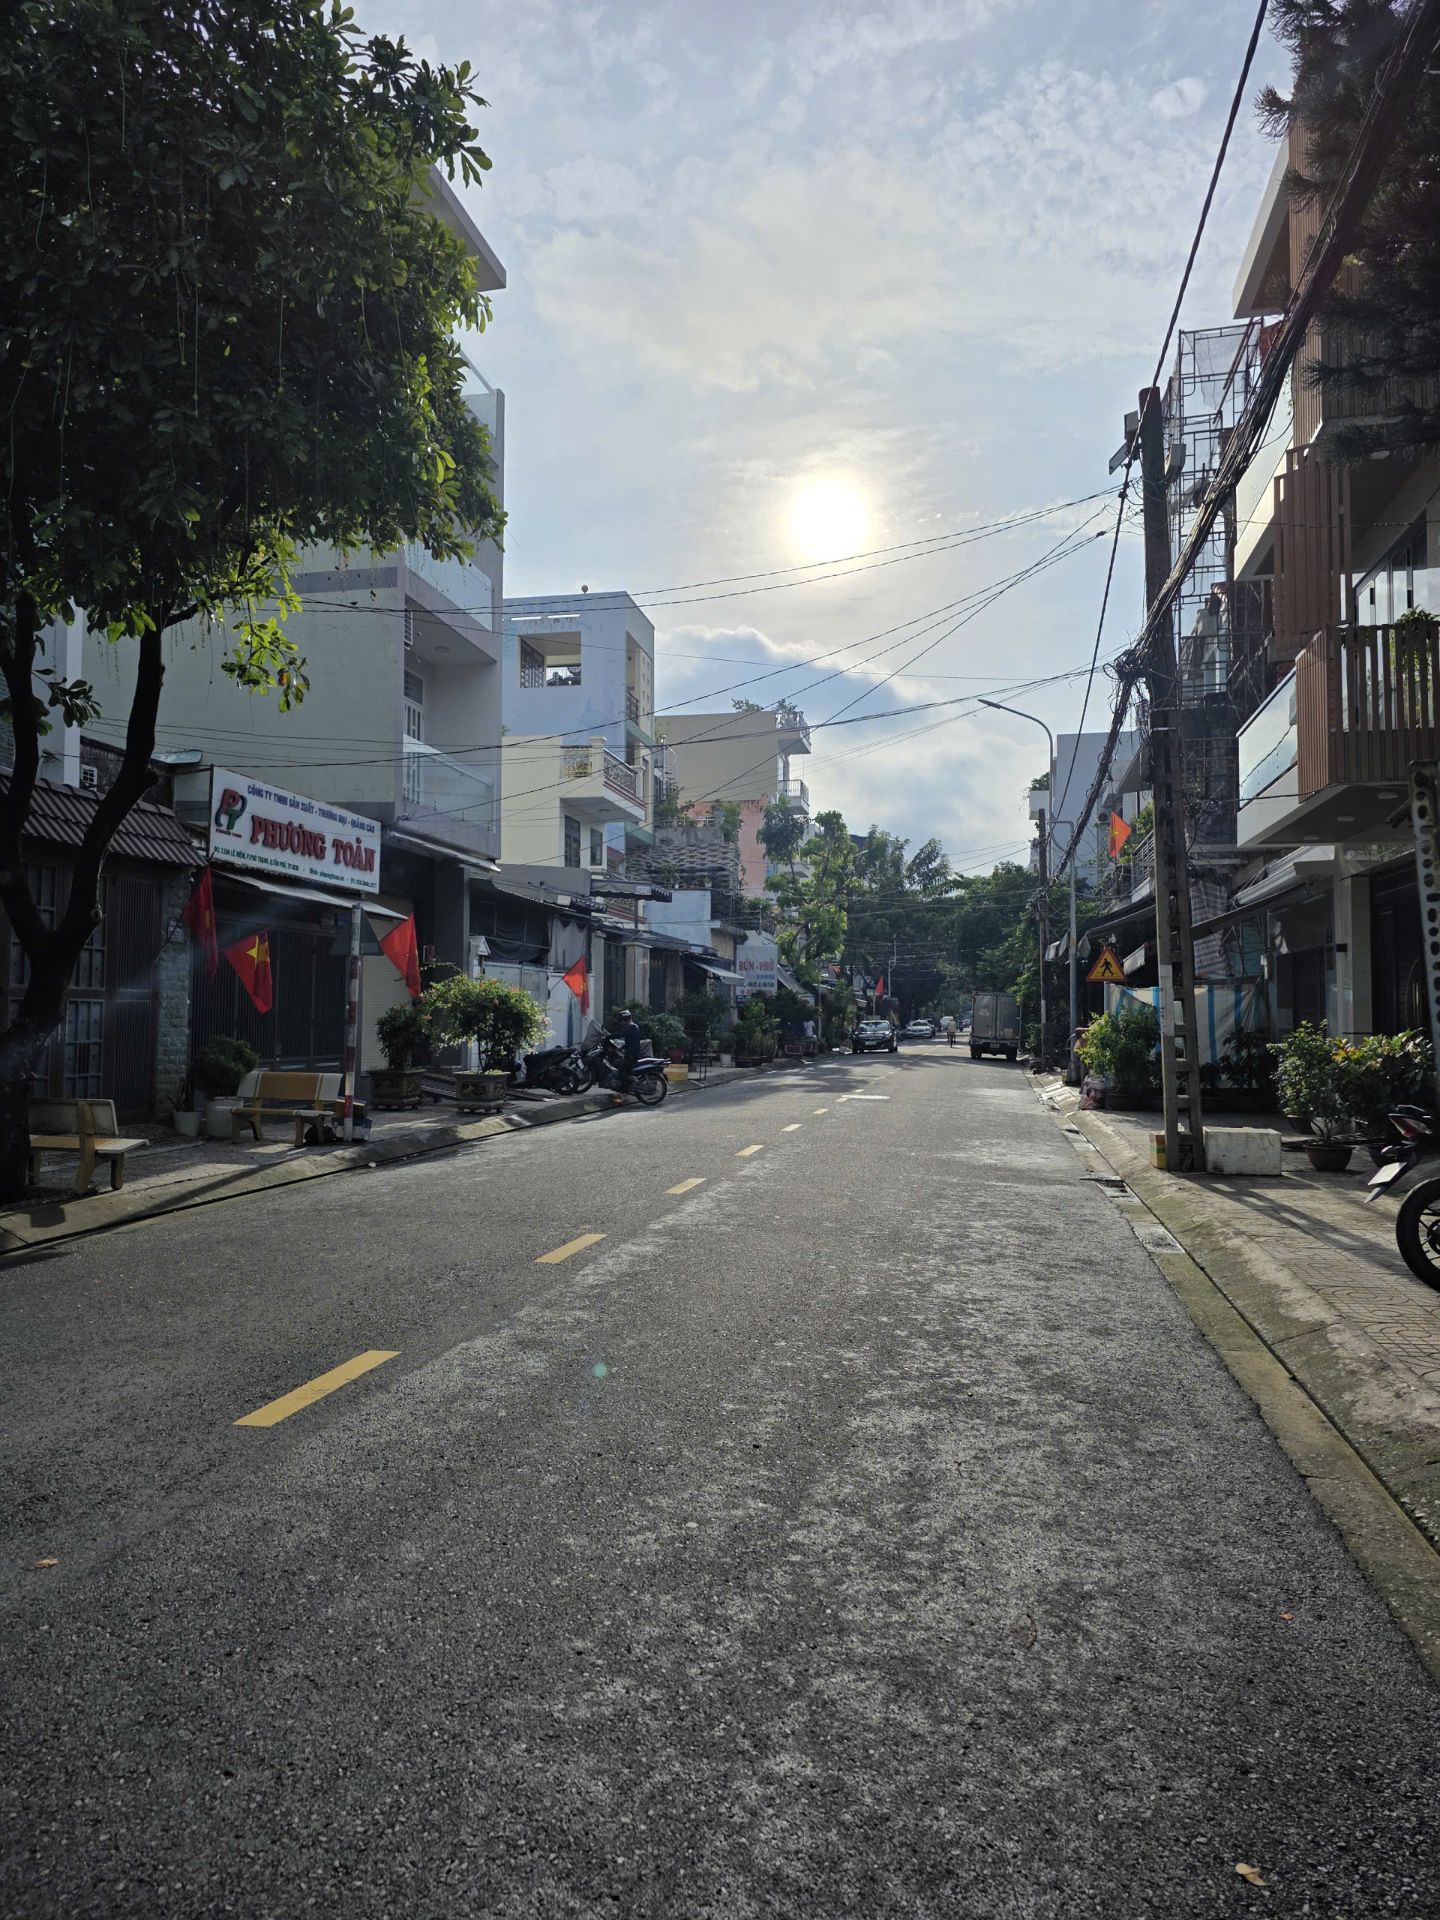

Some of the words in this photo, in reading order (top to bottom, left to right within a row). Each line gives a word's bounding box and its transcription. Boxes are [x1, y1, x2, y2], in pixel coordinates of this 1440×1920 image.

[247, 784, 264, 798] CÔNG
[264, 790, 272, 800] TY
[273, 793, 288, 806] TNHH
[288, 796, 300, 809] SẢN
[300, 801, 314, 814] XUẤT
[350, 817, 366, 831] QUẢNG
[366, 822, 375, 834] CÁO
[250, 814, 327, 860] PHƯƠNG
[332, 837, 376, 872] TOÀN
